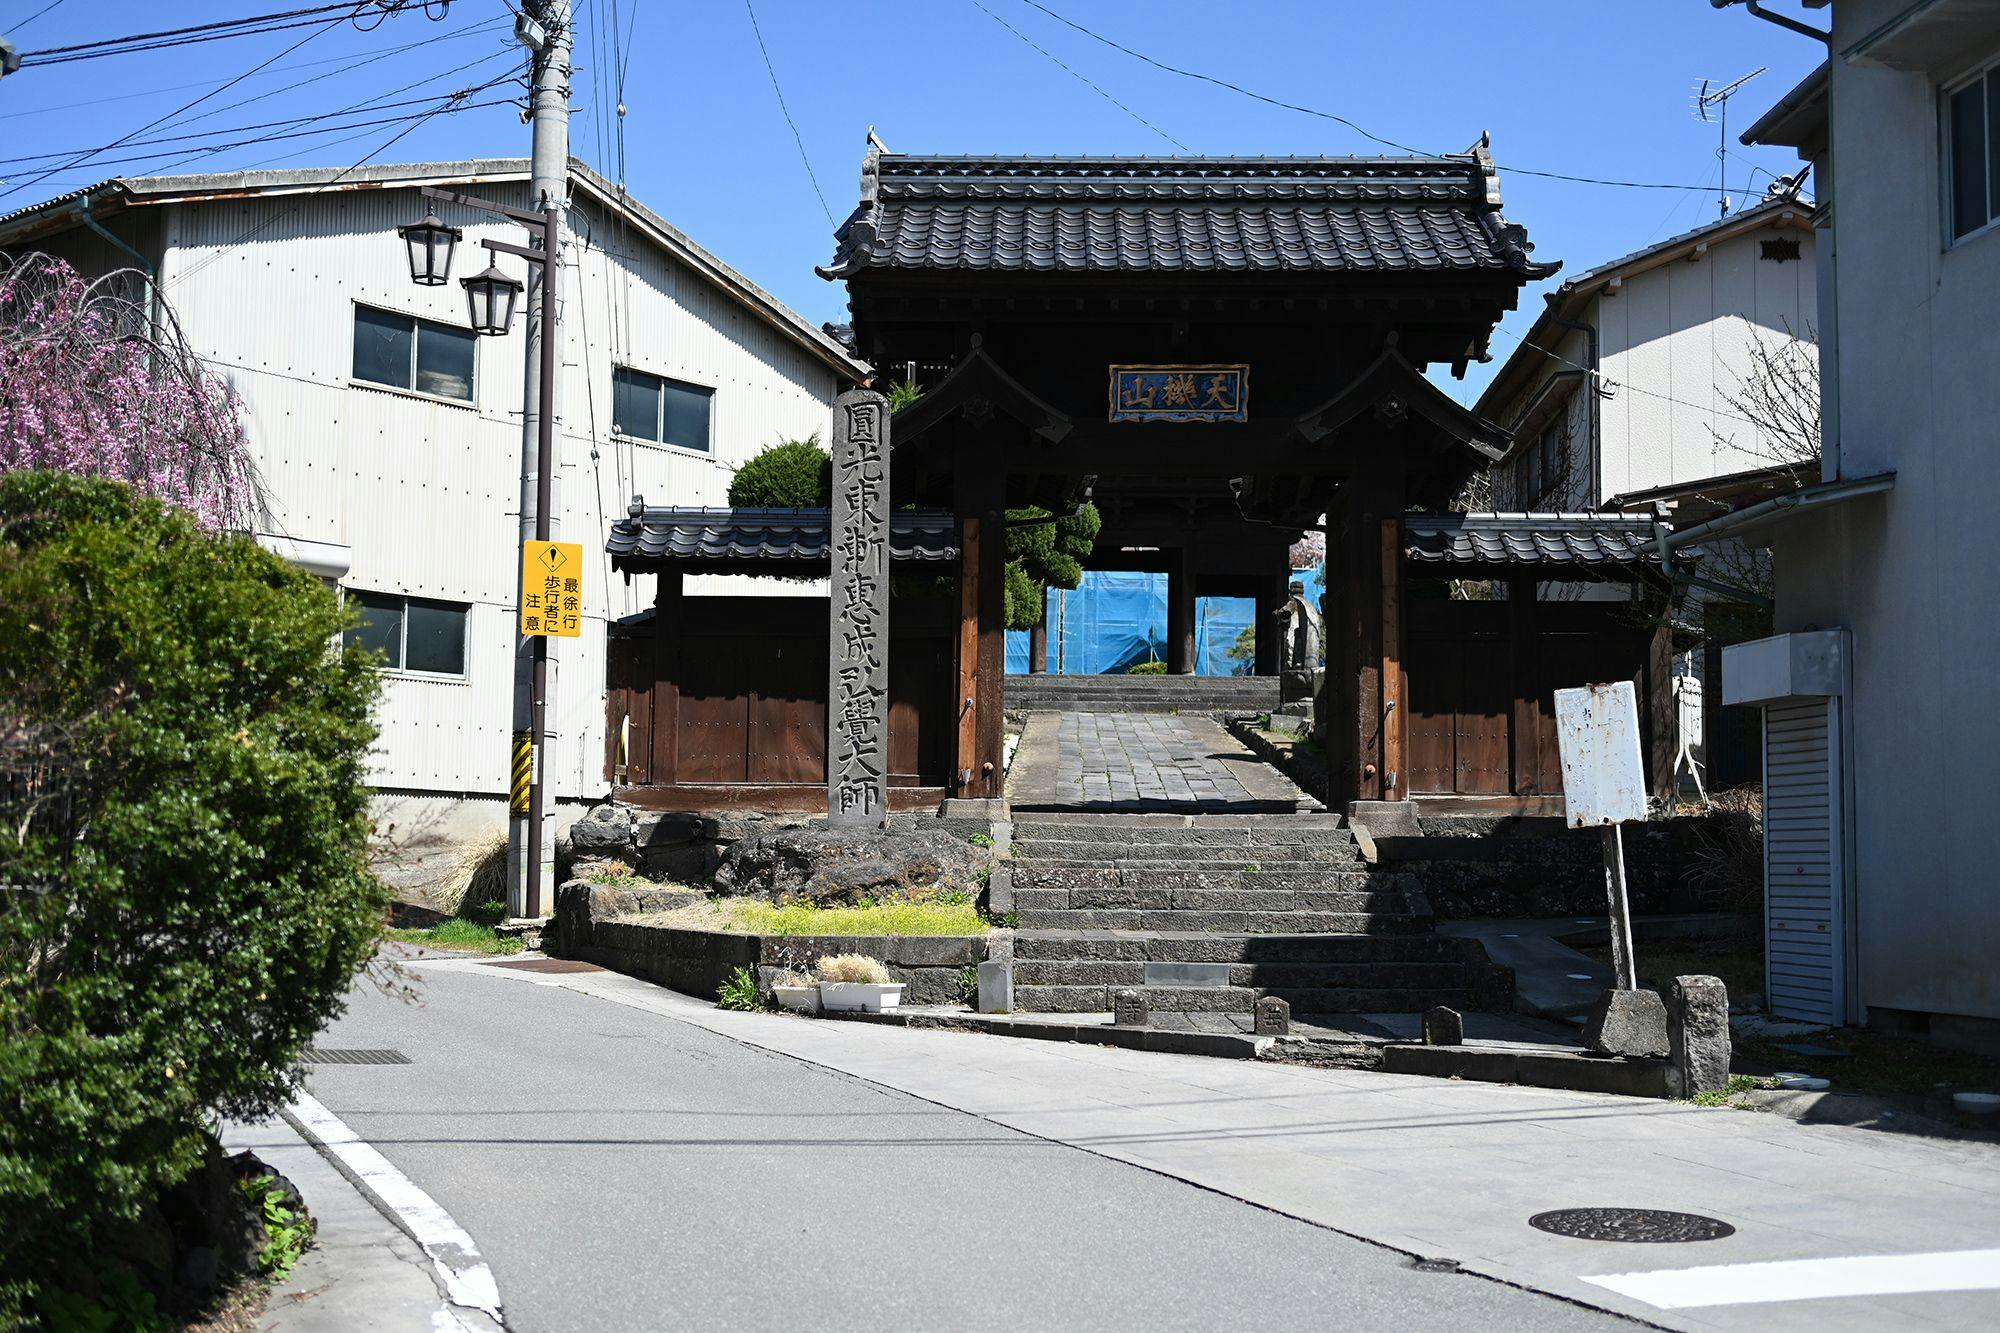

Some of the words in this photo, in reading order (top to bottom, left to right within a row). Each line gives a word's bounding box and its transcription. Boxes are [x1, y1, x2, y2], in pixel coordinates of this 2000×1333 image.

[525, 594, 541, 631] 注意
[544, 575, 561, 632] 歩行者に
[563, 578, 578, 629] 最徐行
